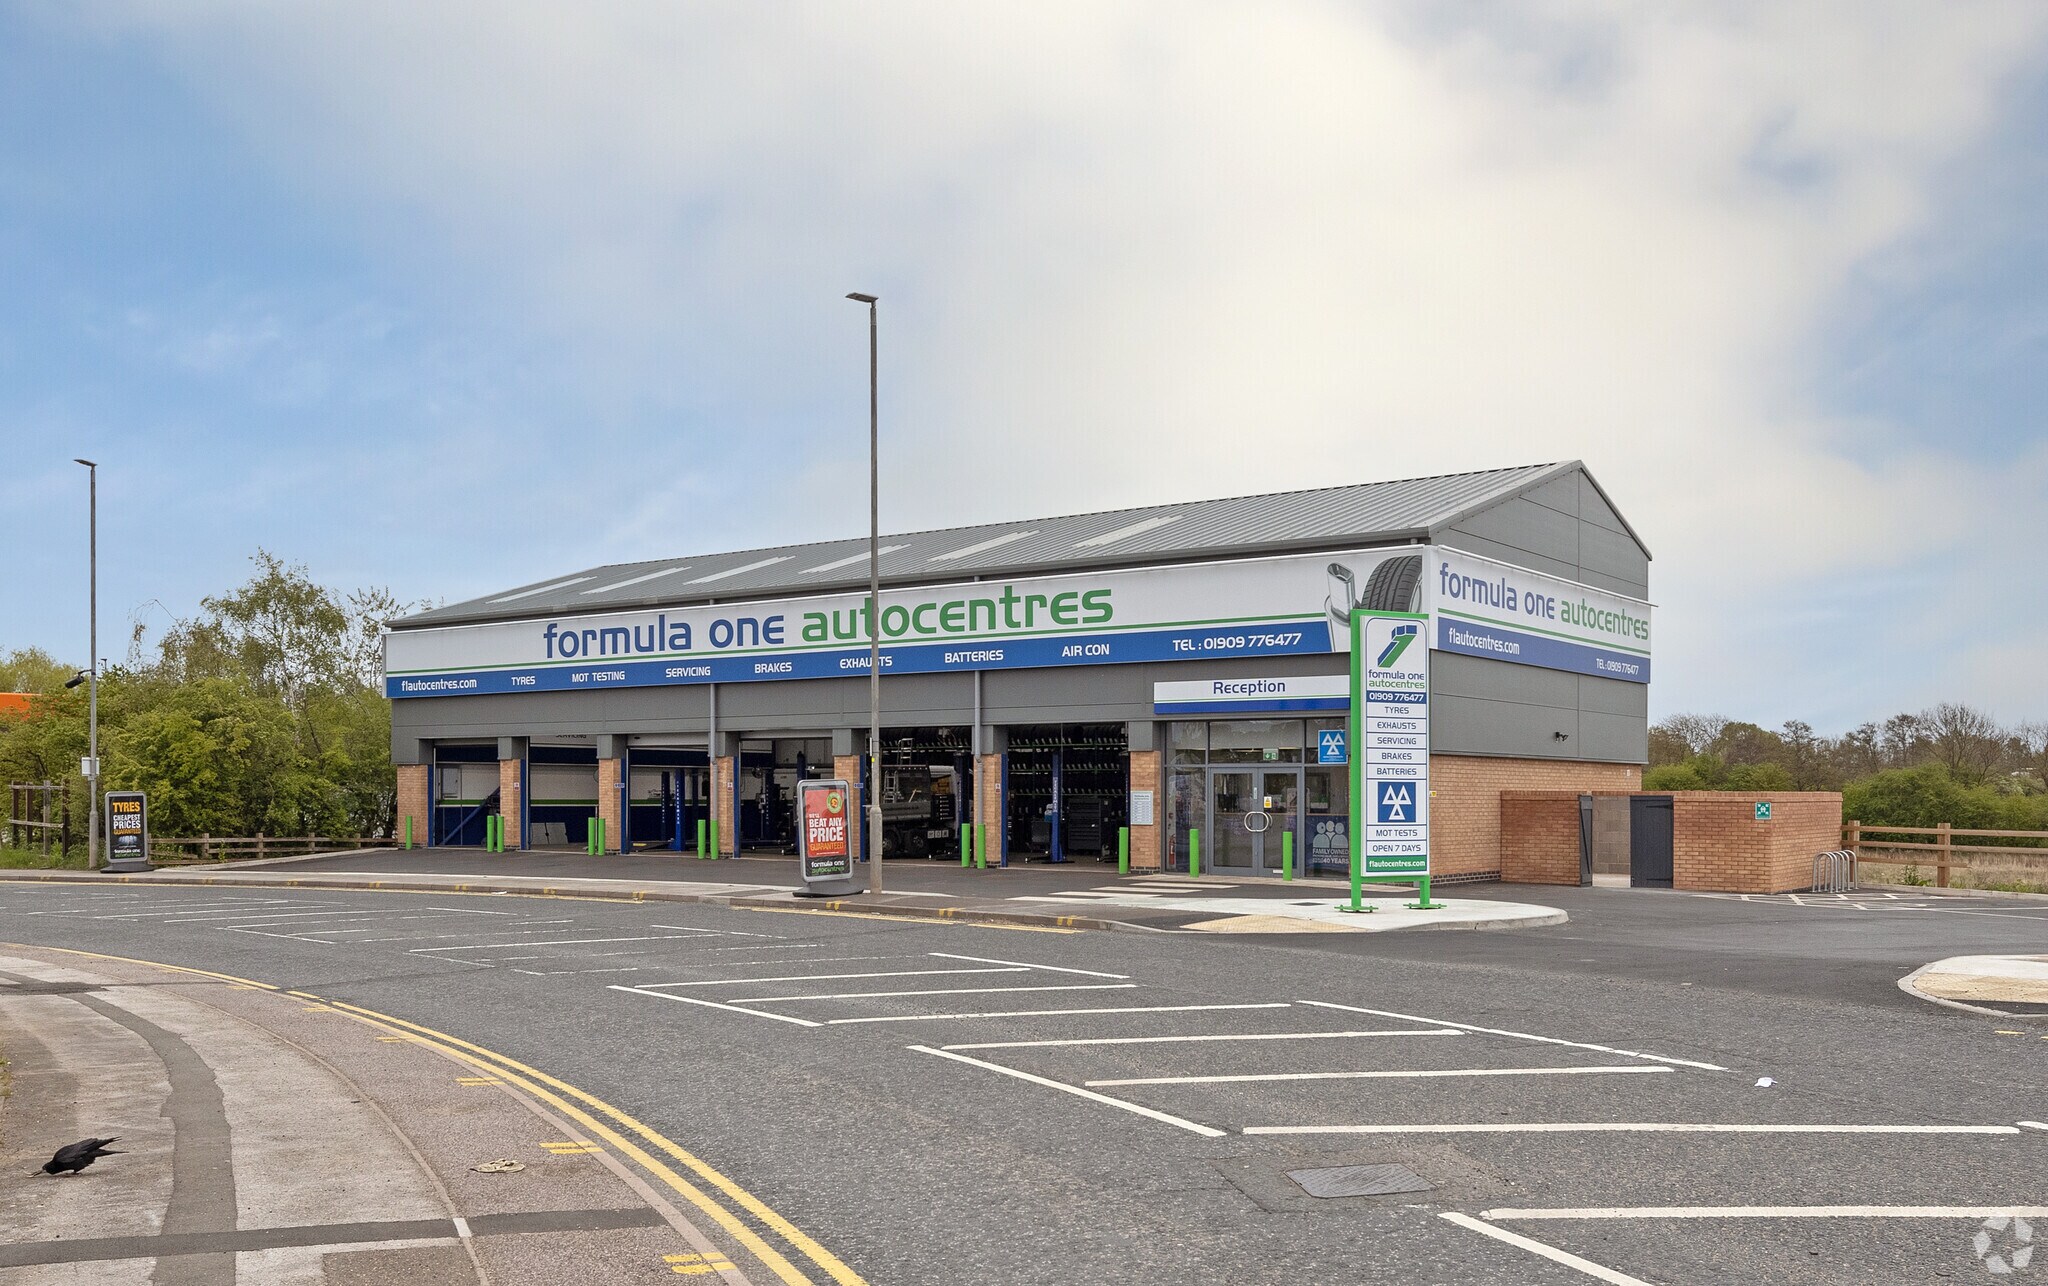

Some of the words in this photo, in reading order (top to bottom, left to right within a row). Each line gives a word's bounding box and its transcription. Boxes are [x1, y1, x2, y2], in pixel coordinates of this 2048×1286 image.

[1440, 563, 1517, 611] formula
[1525, 592, 1555, 620] one
[1561, 598, 1649, 640] autocentres
[543, 614, 692, 659] formula
[709, 615, 784, 647] one
[801, 585, 1114, 642] autocentres
[1204, 636, 1245, 650] 01909
[1248, 633, 1302, 647] 776477
[1449, 628, 1520, 655] f1autocentres.com
[1062, 645, 1083, 657] AIR
[1085, 644, 1110, 656] CON
[944, 649, 1004, 664] BATTERIES
[754, 661, 793, 674] BRAKES
[840, 656, 893, 669] EXHAUTS
[571, 672, 590, 683] MOT
[592, 670, 626, 682] TESTING
[665, 666, 711, 678] SERVICING
[1368, 669, 1405, 680] formula
[1407, 673, 1425, 681] one
[511, 676, 536, 686] TYRES
[1368, 679, 1425, 689] autocentres
[1213, 680, 1286, 696] Reception
[1369, 692, 1393, 701] 01909
[1395, 693, 1424, 702] 776477
[1385, 706, 1409, 714] TYRES
[1377, 722, 1417, 730] EXHAUSTS
[1377, 737, 1417, 745] SERVICING
[1381, 752, 1412, 760] BRAKES
[1376, 767, 1417, 775] BATTERIES
[113, 802, 140, 813] TYRES
[113, 820, 141, 829] PRICES
[809, 818, 827, 828] BEAT
[829, 817, 843, 827] ANY
[810, 827, 843, 842] PRICE
[1376, 829, 1392, 837] MOT
[1394, 829, 1418, 837] TESTS
[1401, 844, 1421, 852] DAYS
[811, 860, 833, 868] formula
